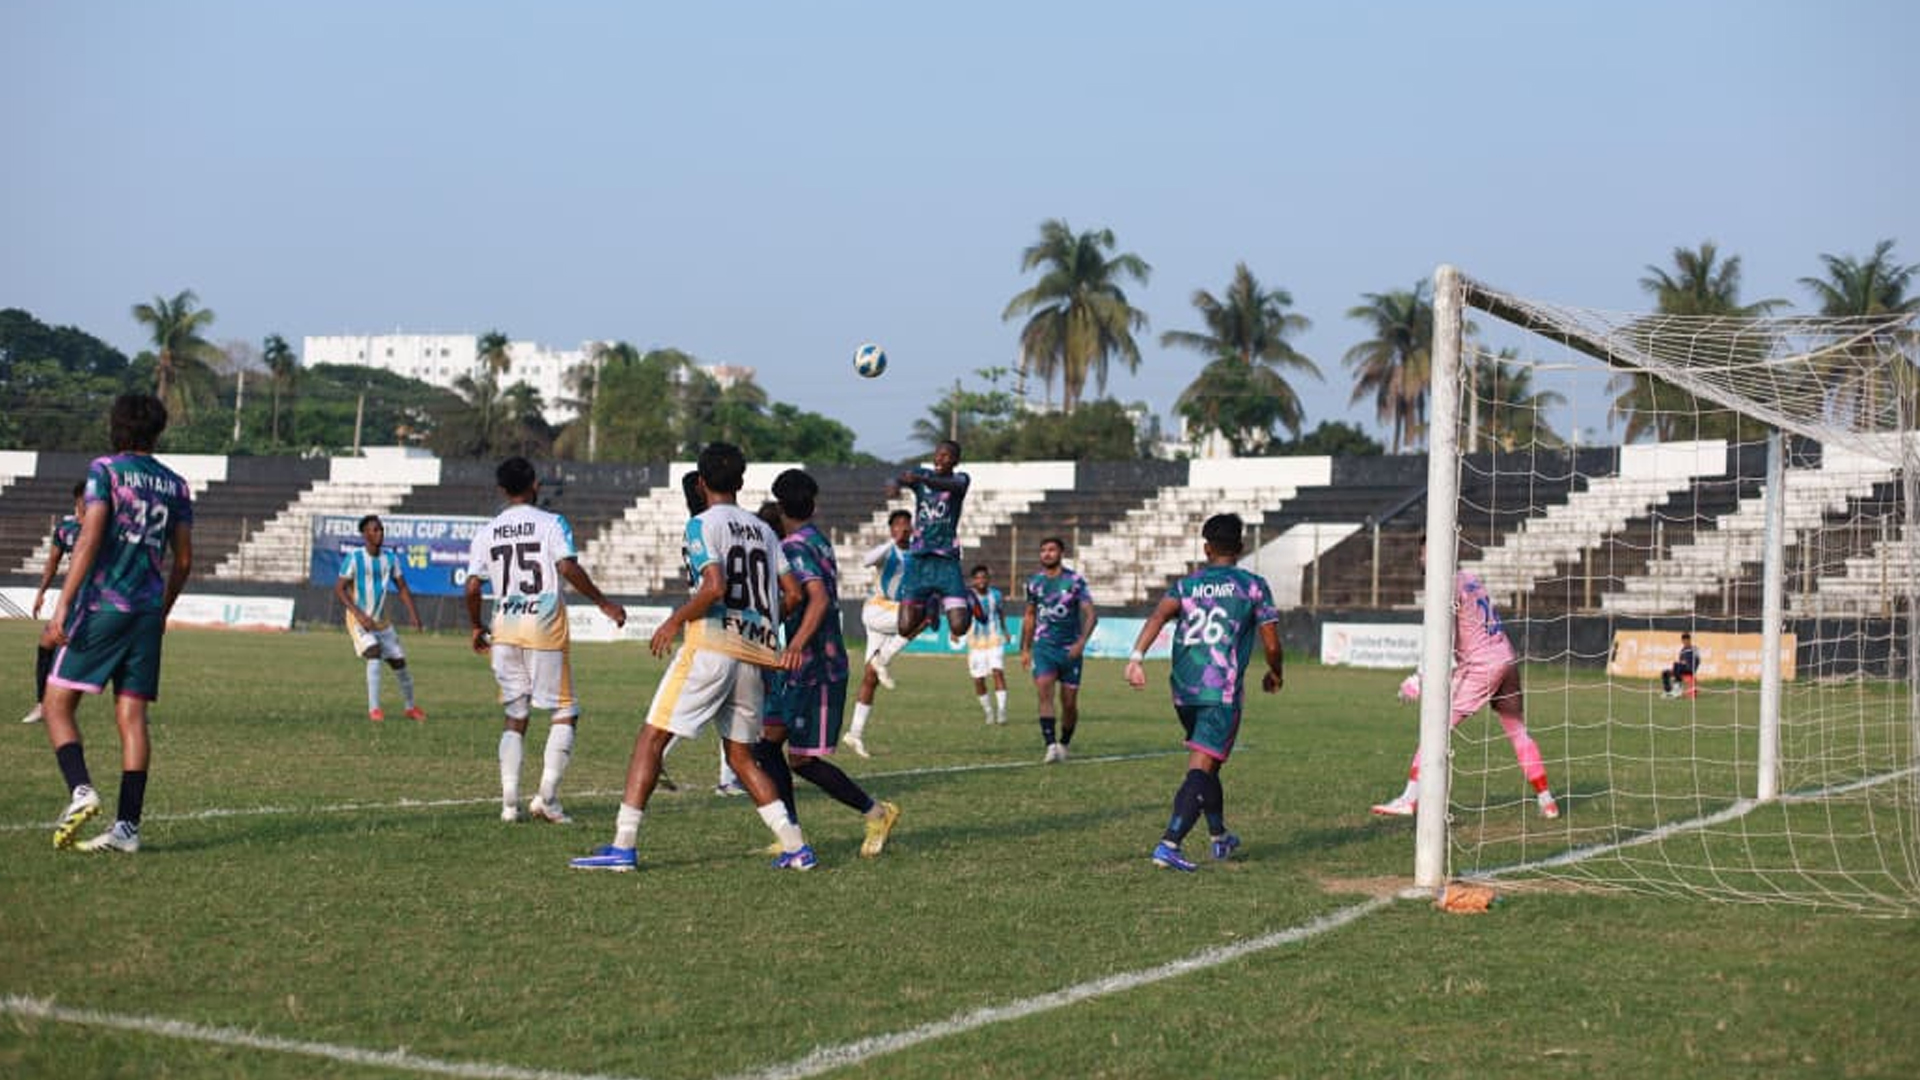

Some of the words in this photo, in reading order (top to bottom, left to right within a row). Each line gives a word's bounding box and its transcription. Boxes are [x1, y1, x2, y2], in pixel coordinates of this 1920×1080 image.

[416, 521, 448, 540] CUP
[493, 521, 536, 541] MEHADI
[490, 542, 543, 598] 75
[725, 544, 773, 622] 80
[1191, 583, 1236, 598] MONIR
[1183, 606, 1228, 645] 26
